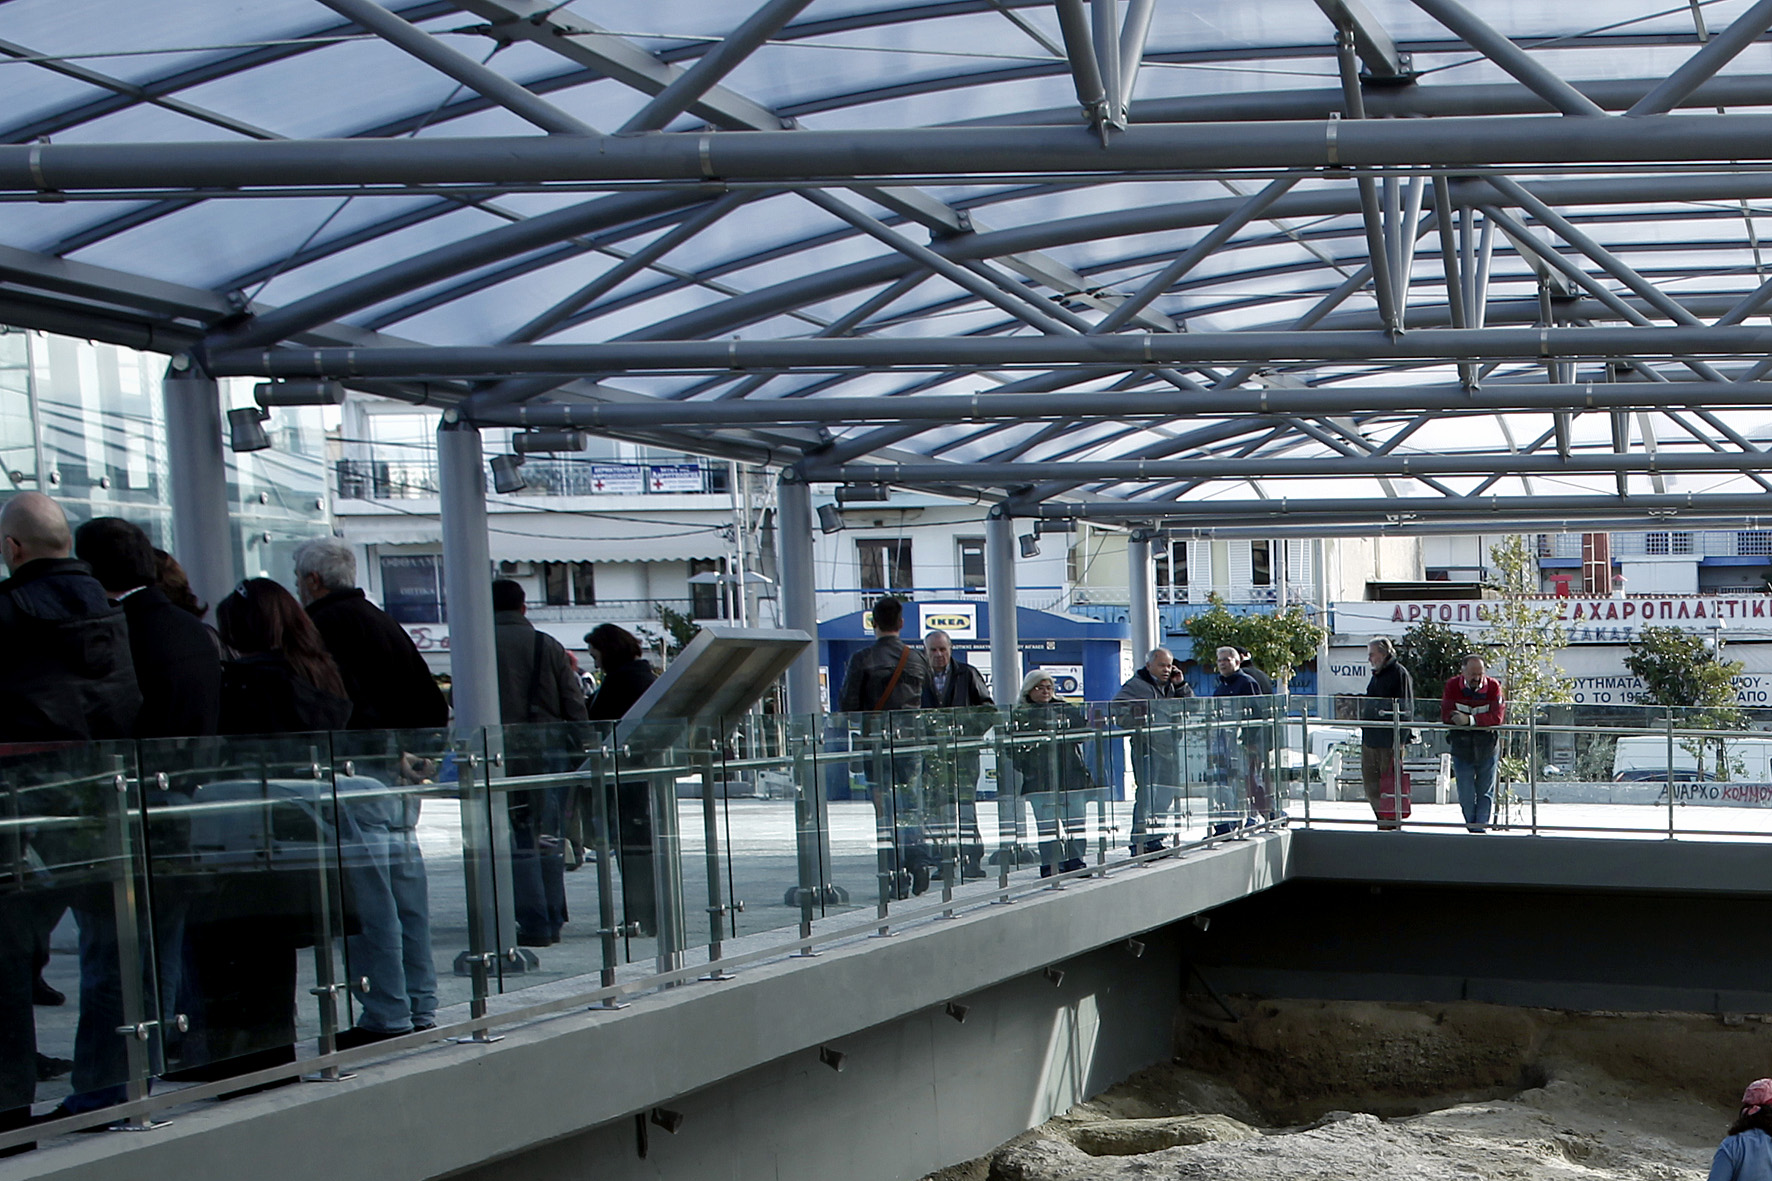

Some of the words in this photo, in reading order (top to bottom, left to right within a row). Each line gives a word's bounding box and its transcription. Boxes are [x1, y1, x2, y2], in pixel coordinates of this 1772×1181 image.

[930, 617, 967, 627] IKEA
[1330, 665, 1367, 677] ΨΩΜΙ
[1559, 677, 1643, 689] ΟΥΤΗΜΑΤΑ
[1592, 692, 1612, 703] ΤΟ
[1737, 691, 1768, 702] ΑΠΟ
